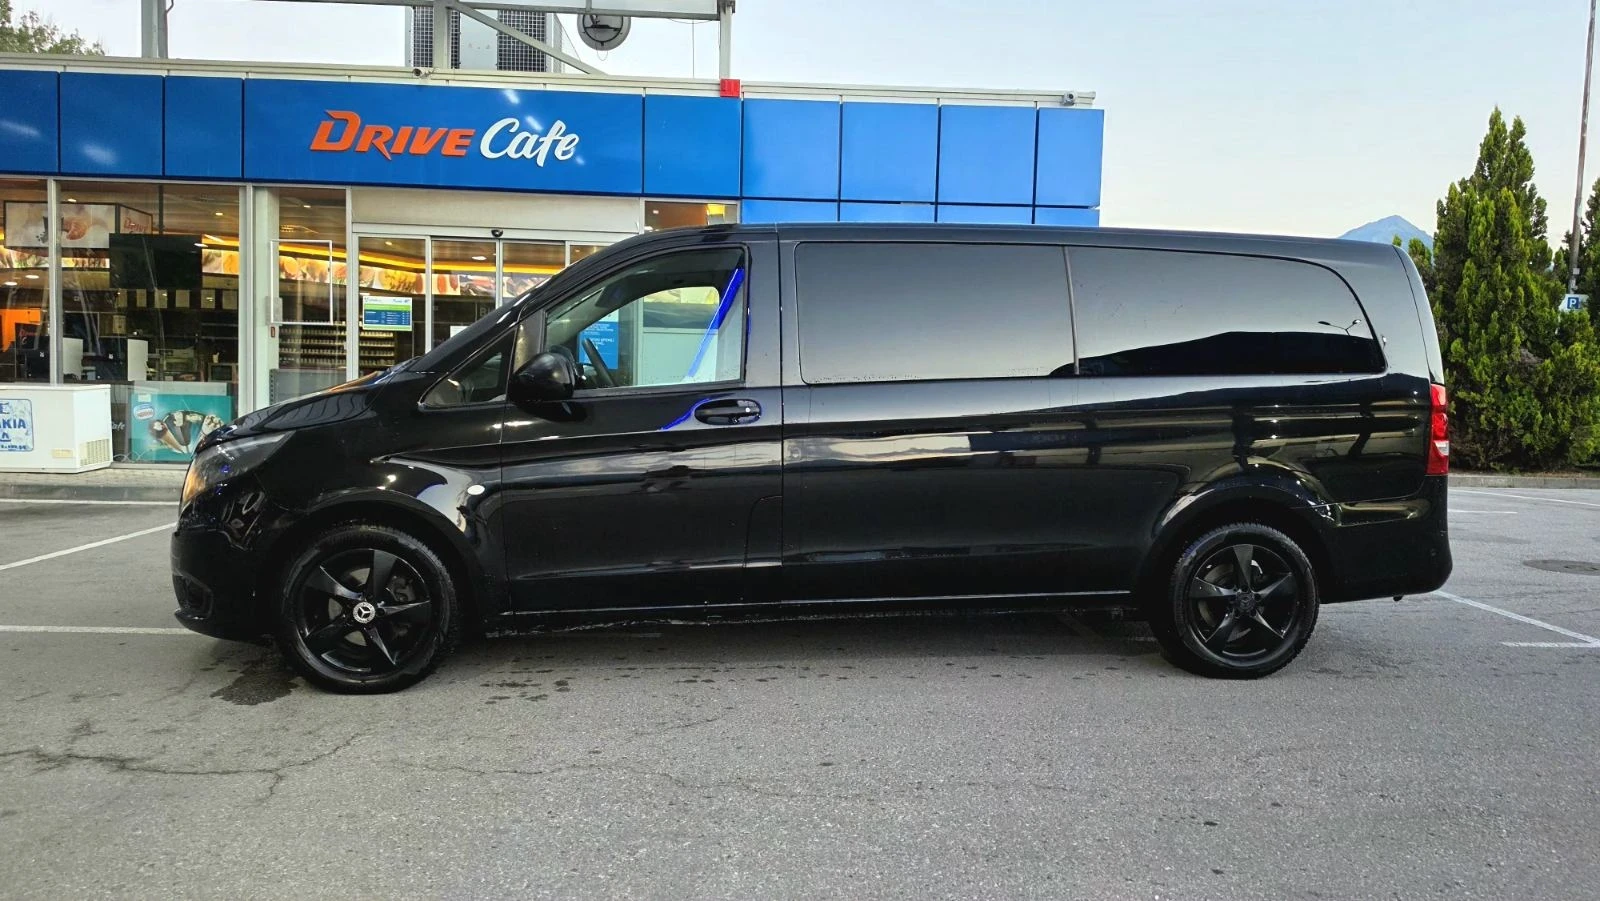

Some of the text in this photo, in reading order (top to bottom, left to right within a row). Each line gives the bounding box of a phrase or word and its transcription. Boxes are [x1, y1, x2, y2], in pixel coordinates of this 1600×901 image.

[310, 109, 579, 167] DRIVE Cafe
[0, 418, 27, 429] KIA
